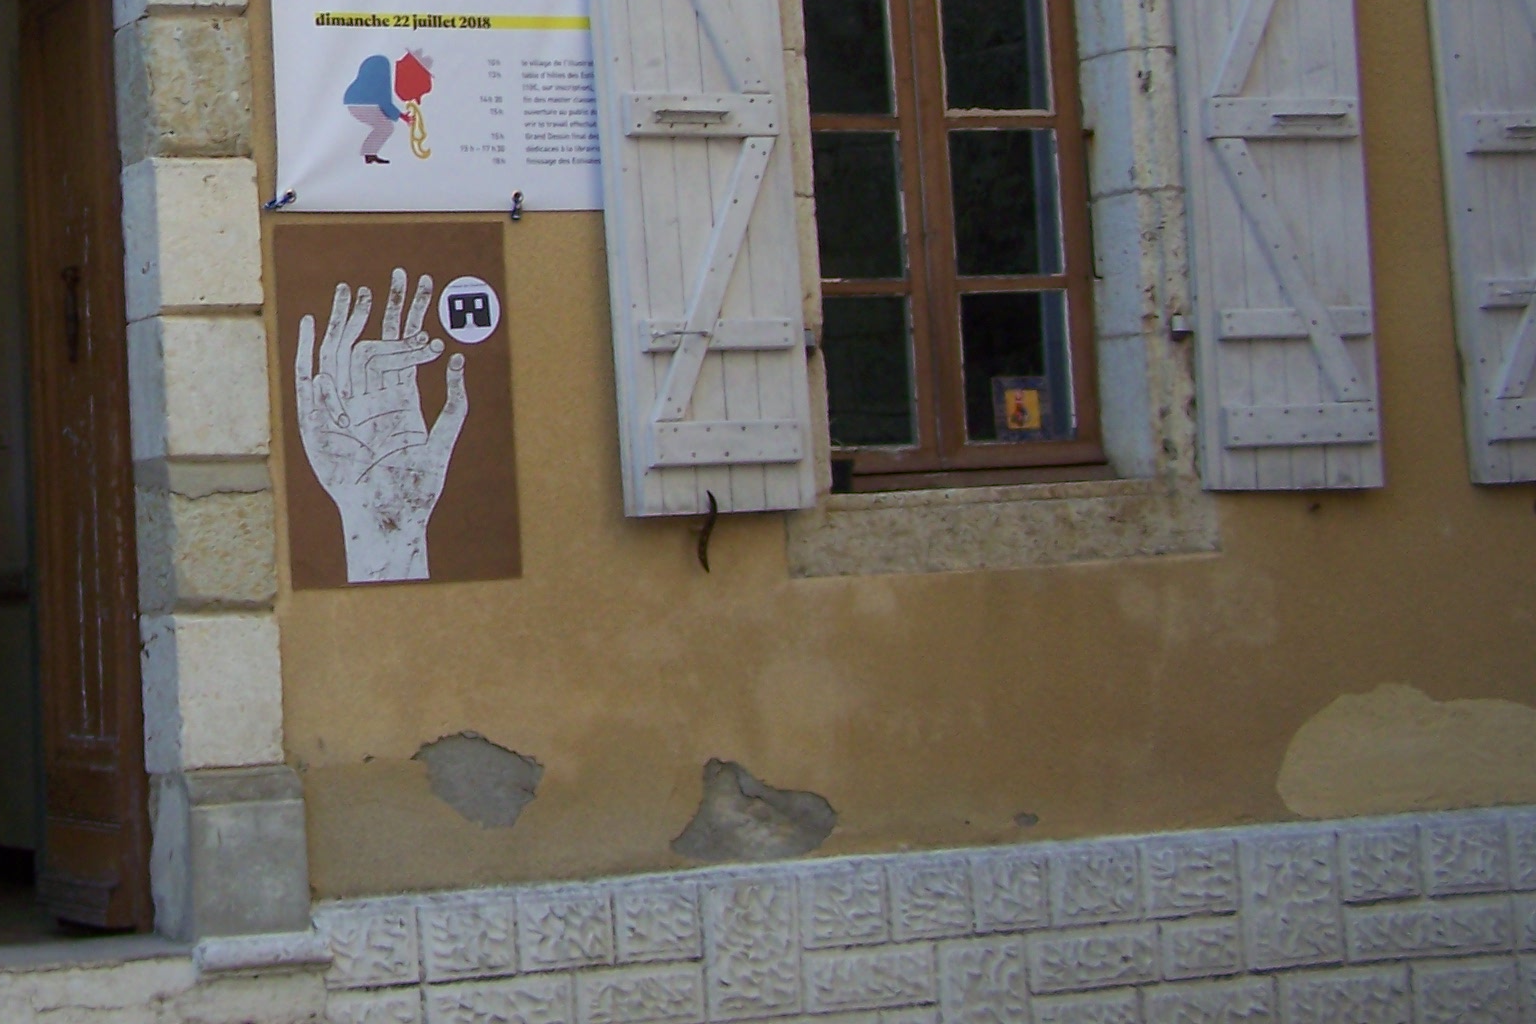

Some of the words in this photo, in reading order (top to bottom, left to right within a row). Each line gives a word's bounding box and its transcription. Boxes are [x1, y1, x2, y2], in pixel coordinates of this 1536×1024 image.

[315, 13, 390, 27] dimanche
[393, 15, 410, 27] 22
[413, 14, 456, 30] juillet
[459, 17, 491, 29] 2018
